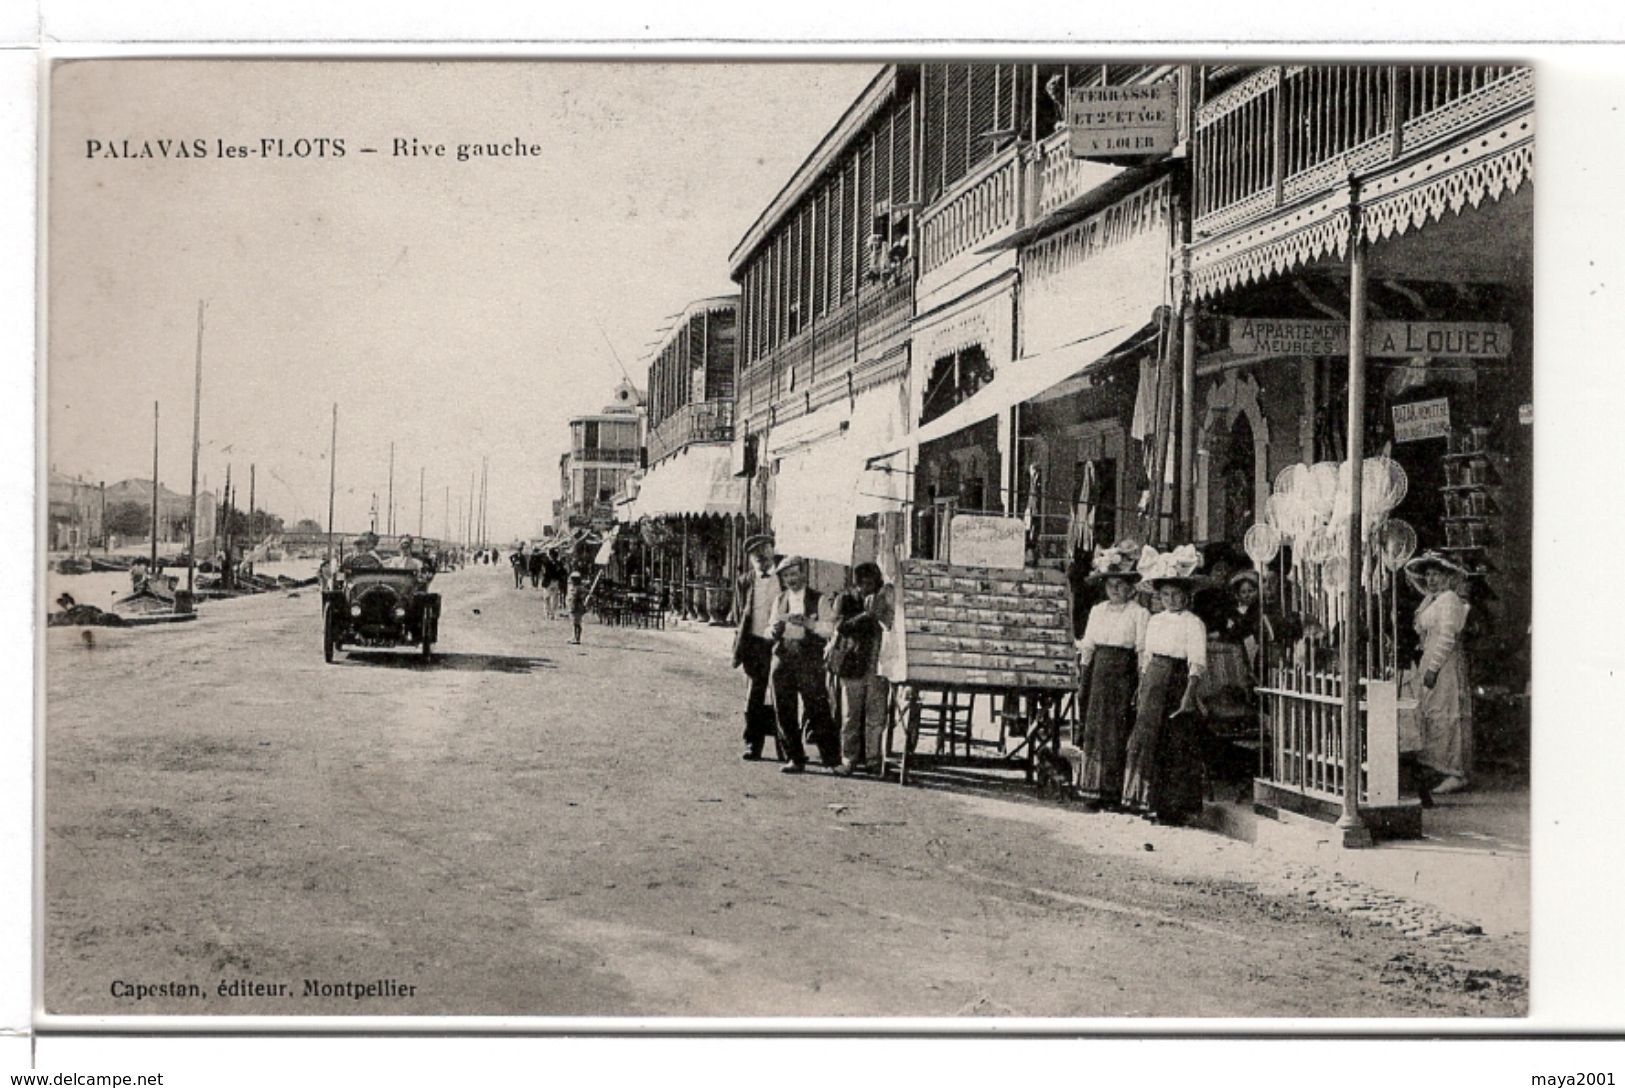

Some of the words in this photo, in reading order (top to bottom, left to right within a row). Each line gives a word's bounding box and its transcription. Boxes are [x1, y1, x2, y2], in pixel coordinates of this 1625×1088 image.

[1078, 88, 1161, 103] TERRASSE
[1075, 112, 1093, 125] ET
[1090, 138, 1099, 150] A
[1106, 136, 1155, 150] LOUER
[1382, 333, 1396, 352] A
[1405, 323, 1500, 353] LOUER
